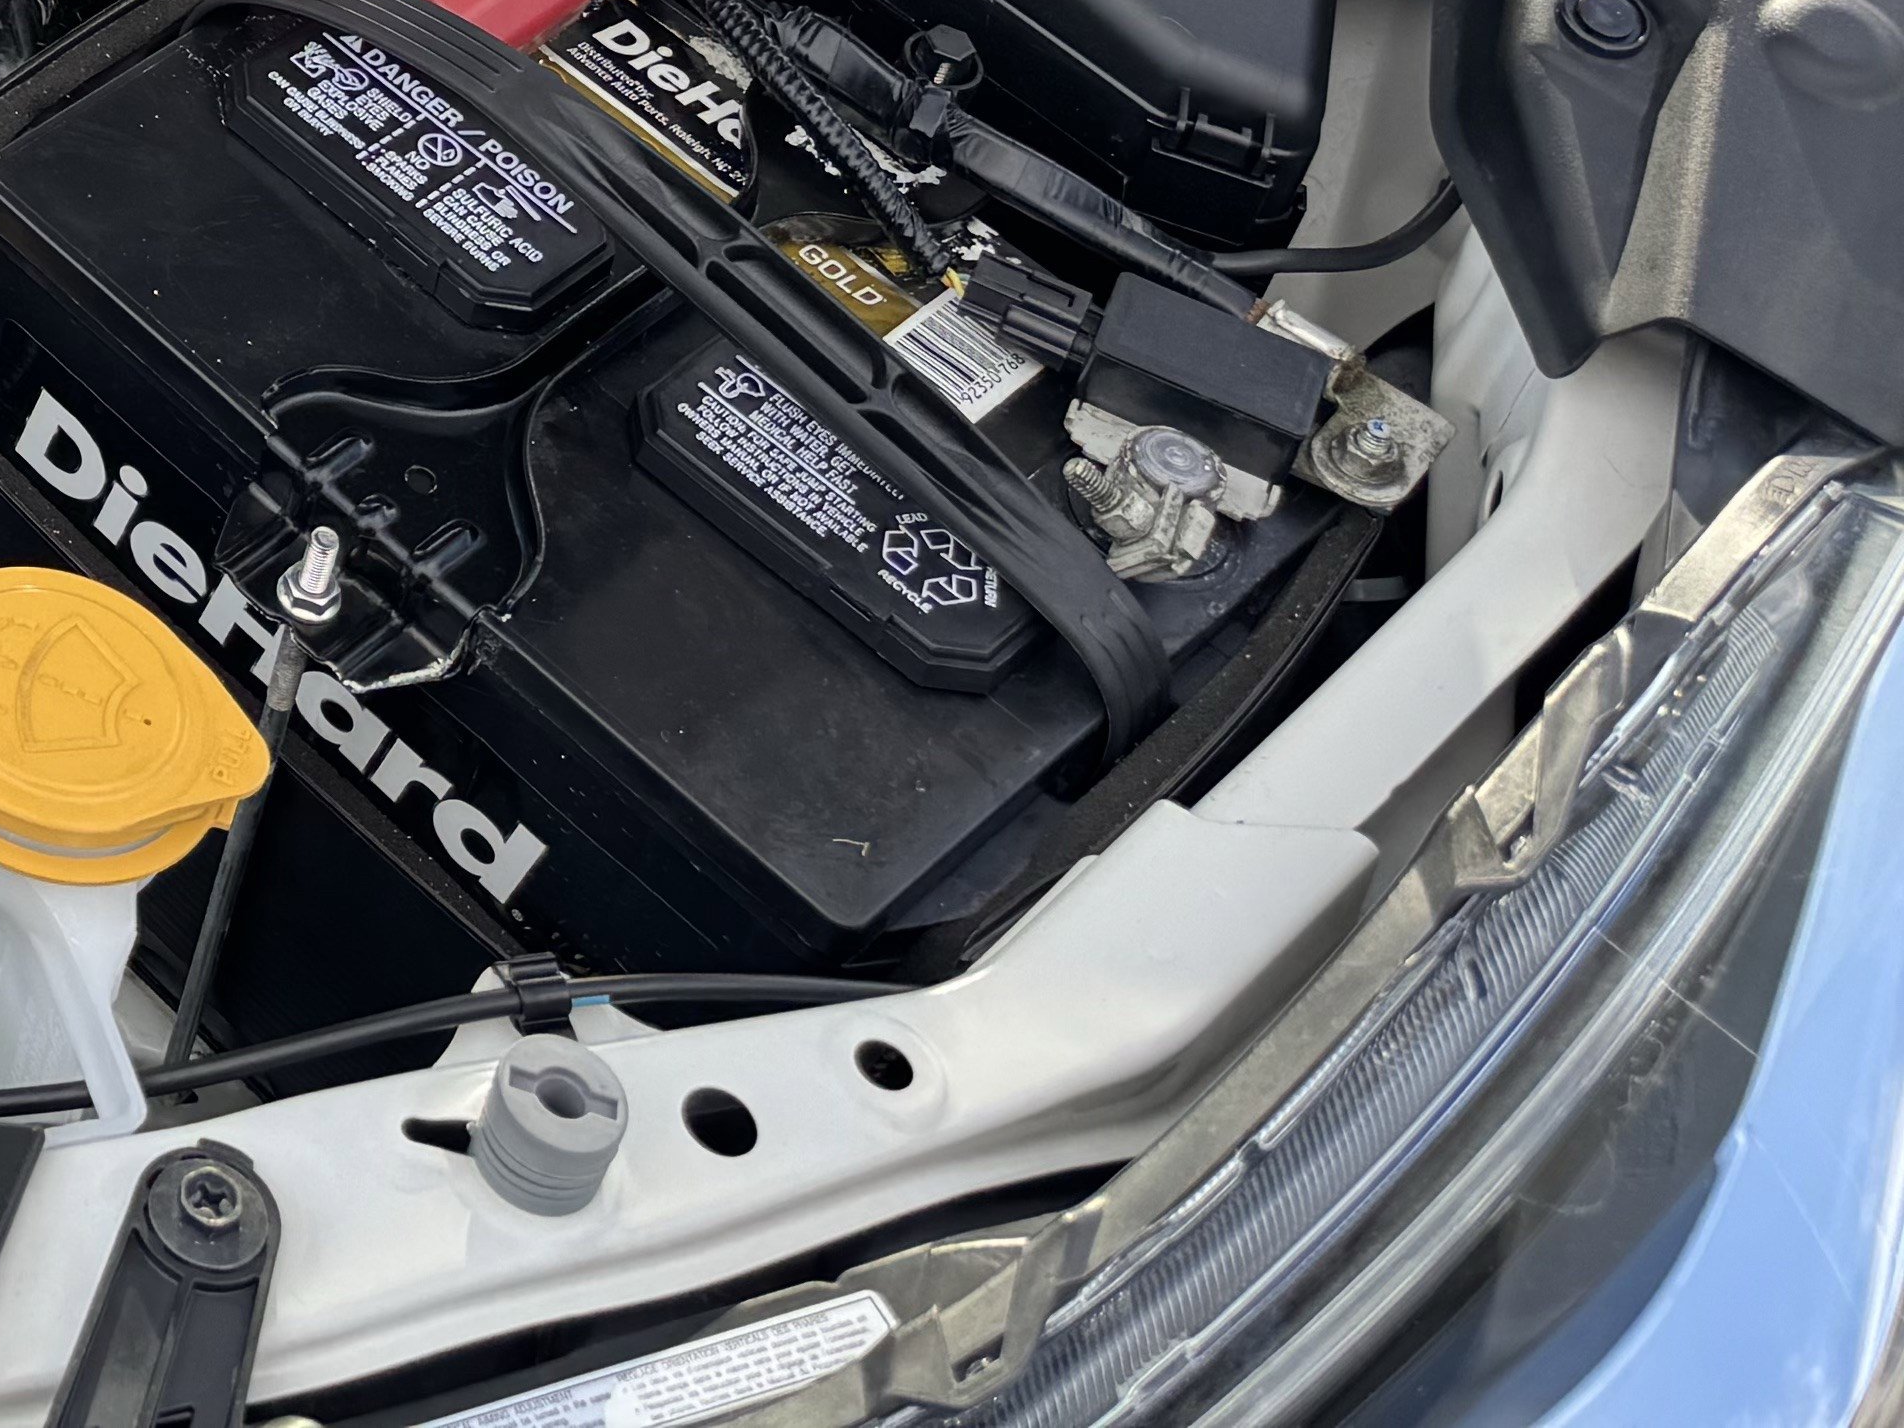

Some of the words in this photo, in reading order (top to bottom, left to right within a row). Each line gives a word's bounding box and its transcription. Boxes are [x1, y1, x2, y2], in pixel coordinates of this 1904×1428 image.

[567, 47, 615, 81] Advance
[610, 81, 639, 101] Auto
[574, 42, 637, 86] Distributed
[307, 86, 349, 120] GASES
[317, 79, 385, 132] EXPLOSIVE
[355, 93, 391, 122] EYES
[366, 87, 412, 123] SHIELD
[361, 47, 465, 128] DANGER
[478, 138, 575, 215] POISON
[366, 161, 415, 202] SMOKING
[375, 156, 419, 191] FLAMES
[404, 150, 431, 171] NO
[422, 208, 466, 244] SEVERE
[442, 194, 468, 217] CAN
[466, 213, 505, 247] CAUSE
[451, 187, 514, 238] SULFURIC
[508, 236, 544, 263] ACID
[491, 249, 512, 266] OR
[798, 244, 886, 306] GOLD
[997, 352, 1027, 377] 768
[760, 401, 791, 427] WITH
[830, 455, 857, 476] GET
[769, 393, 807, 424] FLUSH
[806, 420, 837, 446] EYES
[695, 431, 724, 455] SEEK
[722, 452, 766, 487] SERVICE
[697, 404, 739, 438] FOLLOW
[735, 437, 811, 493] INSTRUCTIONS
[807, 491, 823, 505] IN
[822, 502, 865, 536] VEHICLE
[748, 410, 795, 449] MEDICAL
[796, 446, 828, 470] HELP
[825, 469, 858, 494] FAST
[720, 437, 763, 471] MANUAL
[777, 482, 792, 492] IF
[789, 491, 816, 511] NOT
[812, 511, 868, 552] AVAILABLE
[747, 431, 771, 450] FOR
[769, 448, 798, 472] SAFE
[795, 471, 826, 492] JUMP
[825, 492, 876, 532] STARTING
[894, 512, 929, 526] LEAD
[877, 568, 934, 614] RECYCLE
[209, 727, 254, 787] PULL
